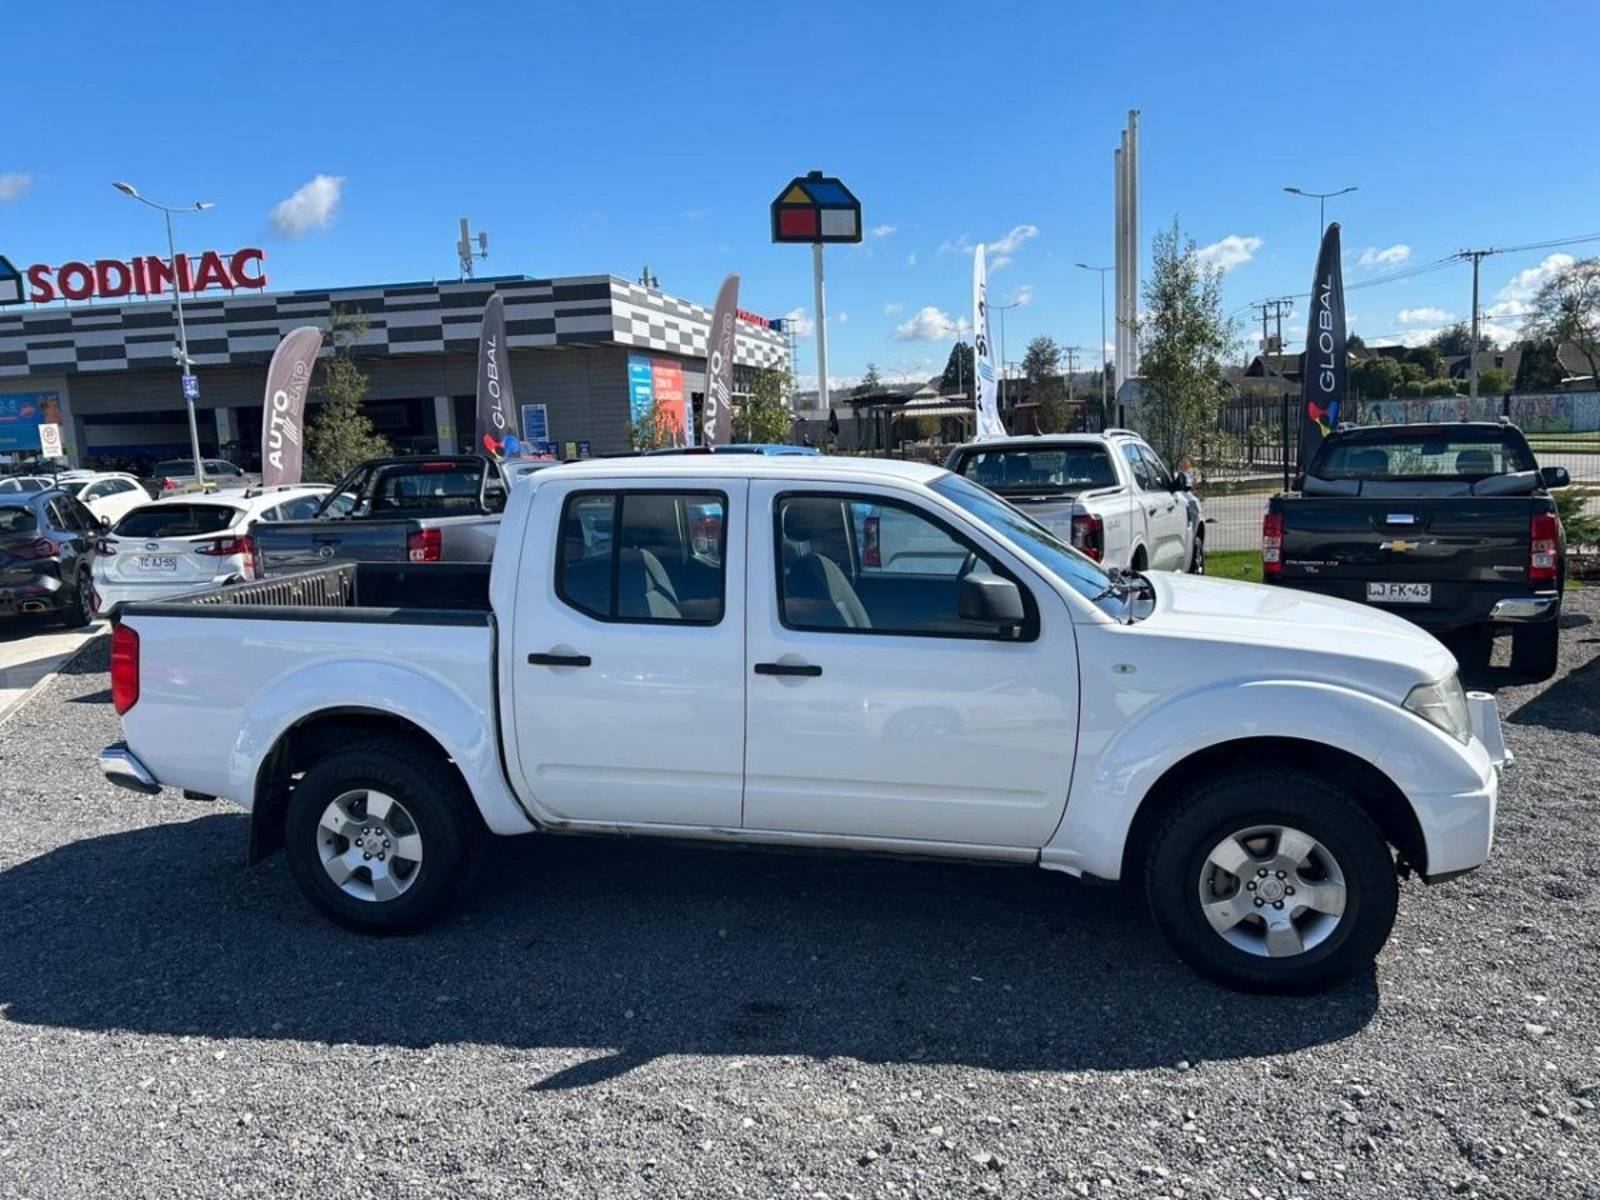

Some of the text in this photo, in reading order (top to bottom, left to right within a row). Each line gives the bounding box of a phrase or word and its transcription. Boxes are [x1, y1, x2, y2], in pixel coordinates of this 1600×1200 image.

[28, 248, 266, 303] SODIMAC
[1320, 274, 1336, 393] GLOBAL
[487, 333, 505, 430] GLOBAL
[703, 350, 723, 440] AUTO
[269, 389, 290, 471] AUTO
